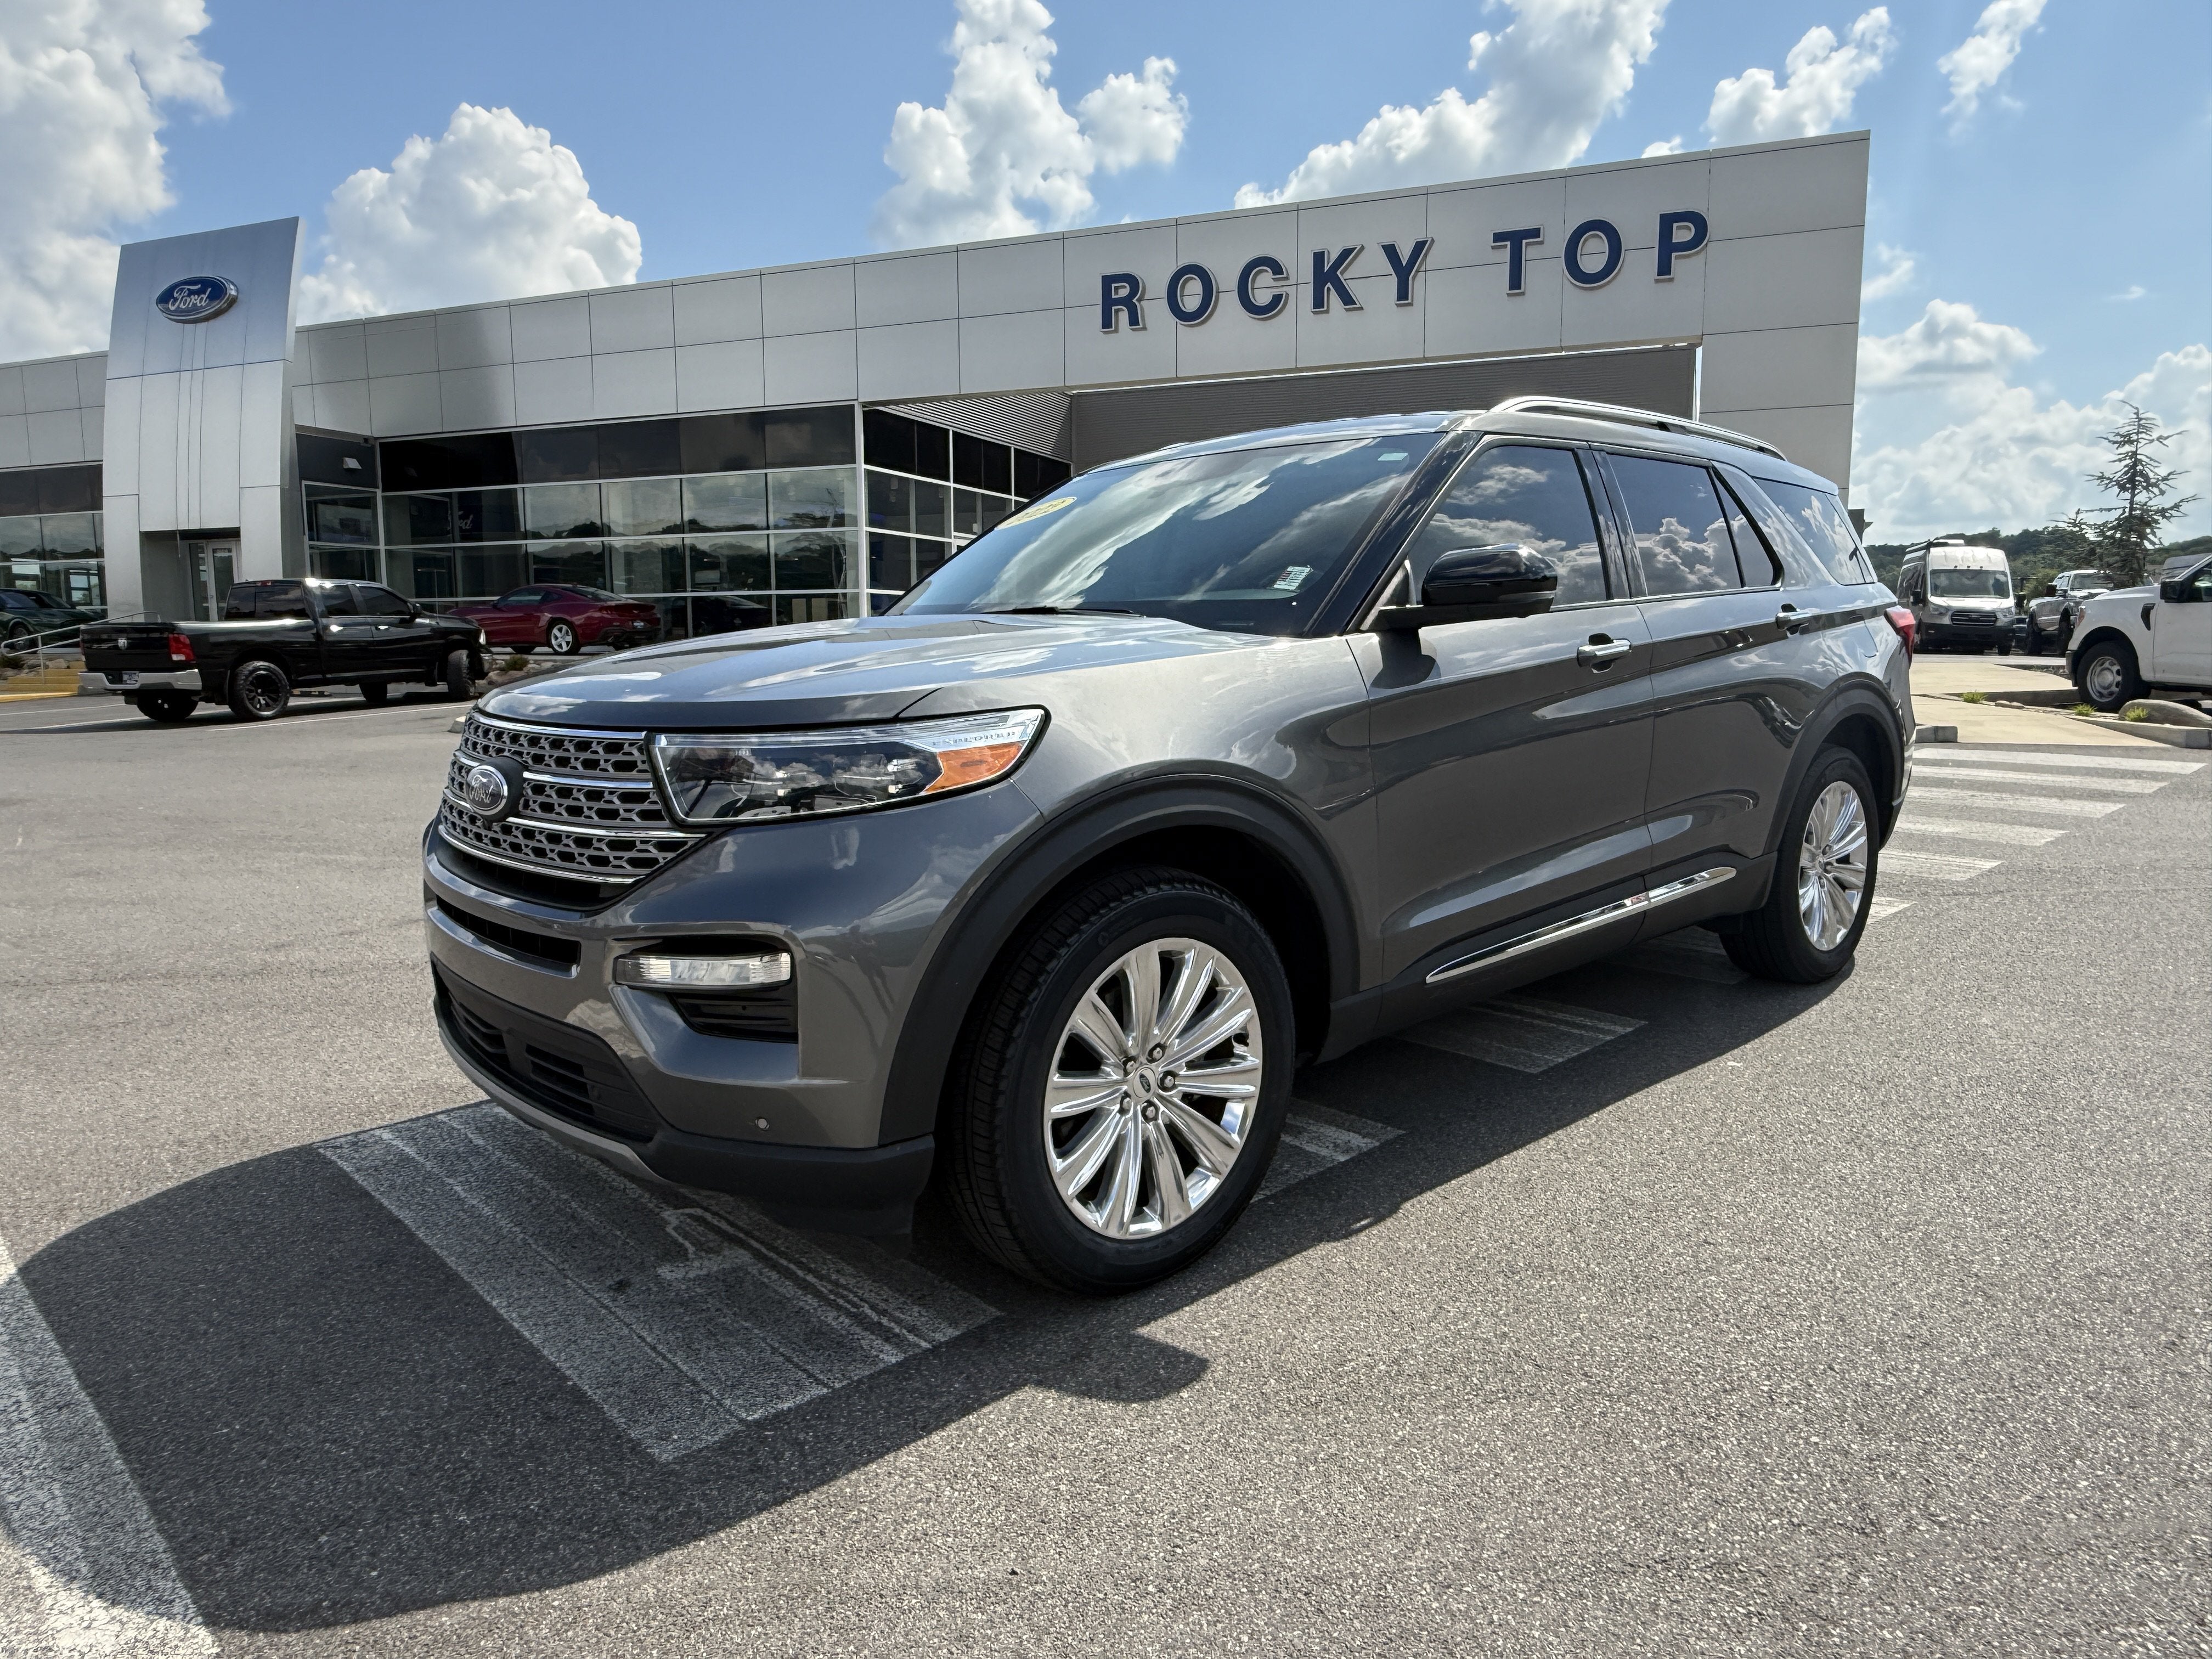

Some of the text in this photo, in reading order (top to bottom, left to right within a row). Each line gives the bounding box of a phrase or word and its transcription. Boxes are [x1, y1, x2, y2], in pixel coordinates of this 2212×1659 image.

[169, 284, 211, 311] Ford
[1099, 209, 1711, 332] ROCKY TOP
